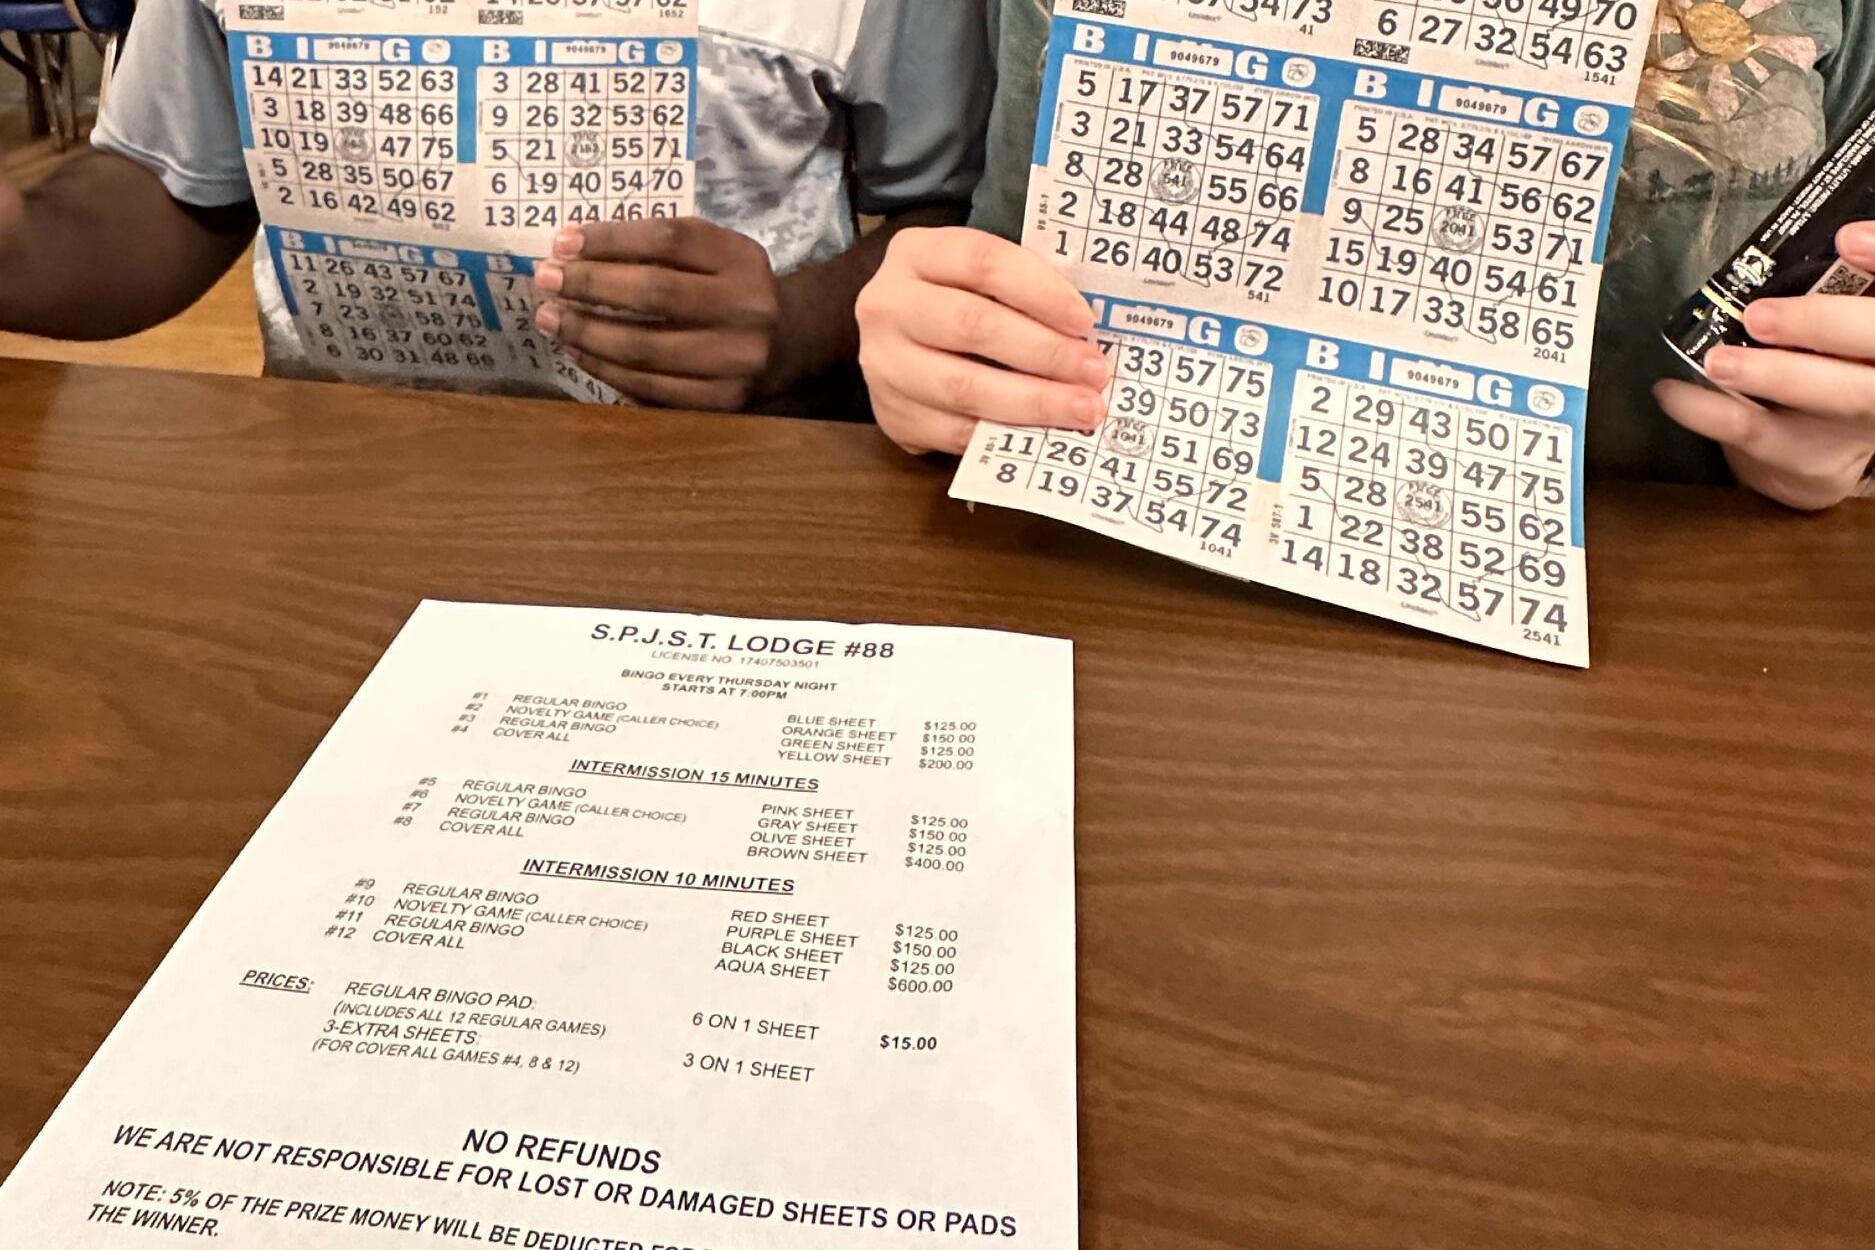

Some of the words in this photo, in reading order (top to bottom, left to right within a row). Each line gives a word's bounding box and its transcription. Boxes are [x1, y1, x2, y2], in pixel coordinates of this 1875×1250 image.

[1171, 51, 1219, 66] 9049679
[253, 65, 283, 86] 14
[291, 67, 322, 89] 21
[335, 69, 367, 90] 33
[379, 70, 410, 91] 52
[421, 70, 454, 91] 63
[1584, 71, 1615, 85] 1541
[1077, 70, 1096, 97] 5
[1118, 78, 1157, 106] 17
[1169, 85, 1210, 114] 37
[1221, 93, 1263, 122] 57
[1272, 101, 1308, 131] 71
[1456, 98, 1507, 114] 9049679
[492, 105, 508, 126] 9
[526, 105, 558, 127] 26
[570, 105, 601, 126] 32
[613, 105, 644, 126] 53
[653, 105, 684, 126] 62
[290, 254, 317, 272] 11
[326, 258, 354, 276] 26
[365, 263, 393, 280] 43
[401, 267, 428, 283] 57
[439, 271, 467, 286] 67
[1248, 290, 1270, 303] 541
[1318, 276, 1358, 307] 10
[1369, 286, 1411, 317] 17
[1422, 296, 1465, 328] 33
[1477, 307, 1520, 339] 58
[1532, 317, 1574, 349] 65
[1126, 314, 1174, 329] 9049679
[1533, 347, 1566, 363] 2041
[1407, 370, 1459, 389] 9049679
[1311, 385, 1331, 414] 2
[1353, 394, 1395, 426] 29
[1409, 407, 1452, 438] 43
[1466, 417, 1510, 450] 50
[1522, 429, 1563, 464] 71
[1200, 541, 1231, 558] 1041
[591, 624, 718, 650] S.P.J.S.T.
[728, 634, 836, 656] LODGE
[844, 641, 894, 658] #88
[1523, 628, 1560, 646] 2541
[652, 650, 708, 663] LICENSE
[620, 668, 664, 680] BINGO
[668, 673, 714, 683] EVERY
[718, 676, 791, 688] THURSDAY
[794, 680, 838, 692] NIGHT
[662, 683, 715, 694] STARTS
[739, 689, 788, 700] 7:00PM
[512, 694, 580, 707] REGULAR
[582, 700, 627, 710] BINGO
[499, 716, 568, 730] REGULAR
[571, 722, 617, 734] BINGO
[506, 705, 572, 719] NOVELTY
[574, 711, 615, 722] GAME
[617, 714, 667, 725] (CALLER
[669, 717, 719, 730] CHOICE)
[787, 714, 824, 725] BLUE
[829, 717, 876, 728] SHEET
[924, 721, 976, 731] $125.00
[493, 727, 545, 740] COVER
[546, 730, 571, 742] ALL
[782, 726, 844, 739] ORANGE
[849, 730, 897, 741] SHEET
[923, 733, 975, 743] $150.00
[780, 738, 833, 750] GREEN
[836, 741, 885, 753] SHEET
[920, 746, 974, 756] $125.00
[778, 750, 839, 763] YELLOW
[842, 754, 892, 766] SHEET
[919, 759, 973, 770] $200.00
[569, 759, 703, 783] INTERMISSION
[710, 770, 730, 783] 15
[734, 773, 819, 792] MINUTES
[418, 776, 437, 787] #5
[462, 779, 535, 795] REGULAR
[538, 784, 587, 799] BINGO
[761, 804, 802, 816] PINK
[805, 807, 854, 819] SHEET
[910, 814, 968, 828] $125.00
[520, 858, 669, 885] INTERMISSION
[674, 872, 697, 886] 10
[701, 874, 795, 895] MINUTES
[239, 969, 314, 994] PRICES:
[344, 981, 432, 1001] REGULAR
[434, 988, 492, 1006] BINGO
[496, 994, 536, 1010] PAD:
[692, 1012, 703, 1026] 6
[708, 1013, 737, 1030] ON
[743, 1019, 750, 1032] 1
[757, 1019, 820, 1040] SHEET
[880, 1034, 937, 1051] $15.00
[462, 1128, 509, 1154] NO
[515, 1134, 662, 1174] REFUNDS
[112, 1124, 157, 1148] WE
[154, 1130, 213, 1156] ARE
[212, 1138, 271, 1162] NOT
[272, 1143, 454, 1181] RESPONSIBLE
[457, 1164, 513, 1190] FOR
[518, 1171, 589, 1199] LOST
[594, 1180, 632, 1204] OR
[639, 1186, 774, 1218] DAMAGED
[782, 1200, 888, 1228] SHEETS
[896, 1208, 936, 1232] OR
[945, 1212, 1017, 1238] PADS
[86, 1203, 131, 1224] THE
[132, 1209, 219, 1238] WINNER.
[101, 1179, 167, 1202] NOTE:
[170, 1188, 201, 1207] 5%
[205, 1191, 239, 1211] OF
[241, 1196, 284, 1216] THE
[284, 1201, 349, 1224] PRIZE
[349, 1207, 431, 1233] MONEY
[433, 1217, 482, 1240] WILL
[488, 1225, 520, 1246] BE
